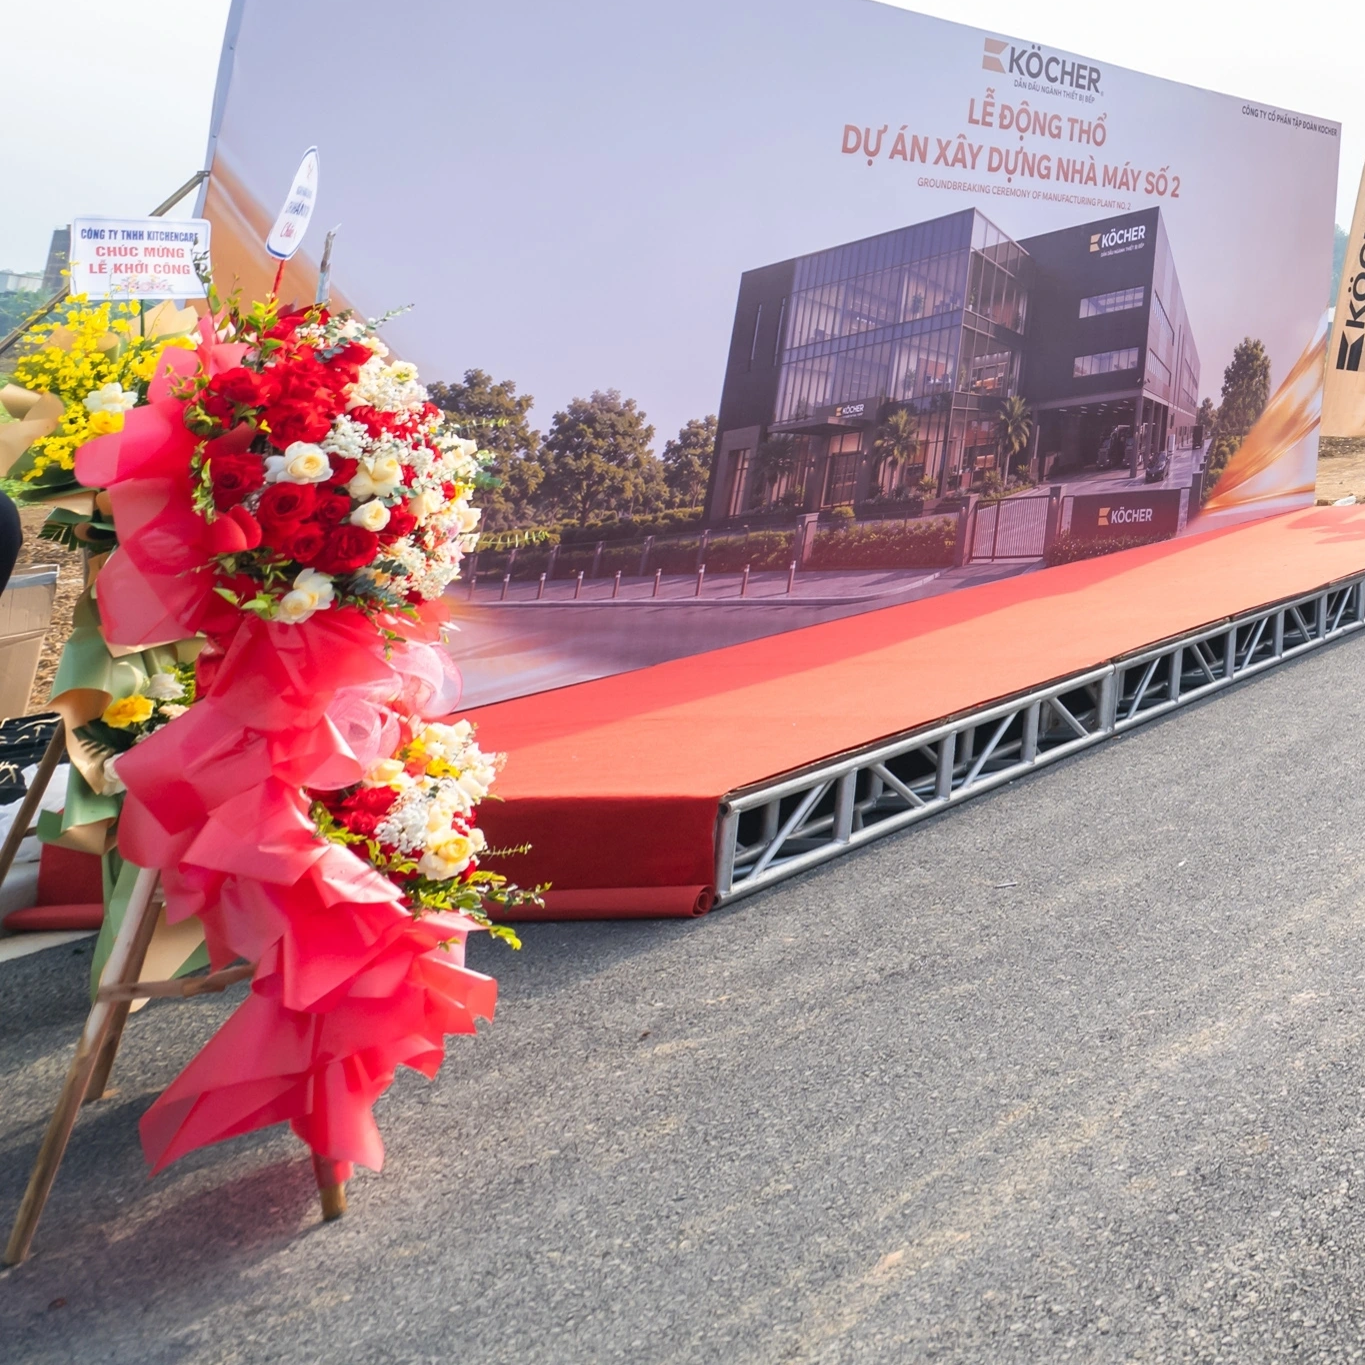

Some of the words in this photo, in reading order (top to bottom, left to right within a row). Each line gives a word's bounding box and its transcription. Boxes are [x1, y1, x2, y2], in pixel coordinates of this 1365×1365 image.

[1008, 44, 1101, 93] KÖCHER
[968, 87, 996, 128] LỄ
[998, 100, 1062, 142] ĐỘNG
[1067, 112, 1108, 148] THỔ
[1242, 104, 1259, 118] CÔNG
[1260, 110, 1267, 119] TY
[841, 124, 888, 167] DỰ
[889, 125, 929, 164] ÁN
[933, 133, 984, 170] XÂY
[987, 146, 1051, 184] DỰNG
[1055, 156, 1098, 187] NHÀ
[1101, 162, 1142, 193] MÁY
[1144, 166, 1172, 197] SỐ
[1170, 176, 1181, 199] 2
[917, 177, 991, 195] GROUNDBREAKING
[992, 186, 1031, 199] CEREMONY
[1032, 191, 1041, 200] OF
[1042, 192, 1096, 207] MANUFACTURING
[1096, 198, 1116, 209] PLANT
[1127, 202, 1132, 211] 2
[80, 226, 106, 240] CÔNG
[108, 229, 118, 240] TY
[121, 229, 144, 241] TNHH
[1101, 225, 1146, 248] KÖCHER
[95, 243, 139, 258] CHÚC
[143, 244, 185, 259] MỪNG
[89, 260, 107, 275] LỄ
[113, 260, 149, 275] KHỞI
[153, 262, 191, 275] CÔNG
[1110, 507, 1153, 524] KÖCHER
